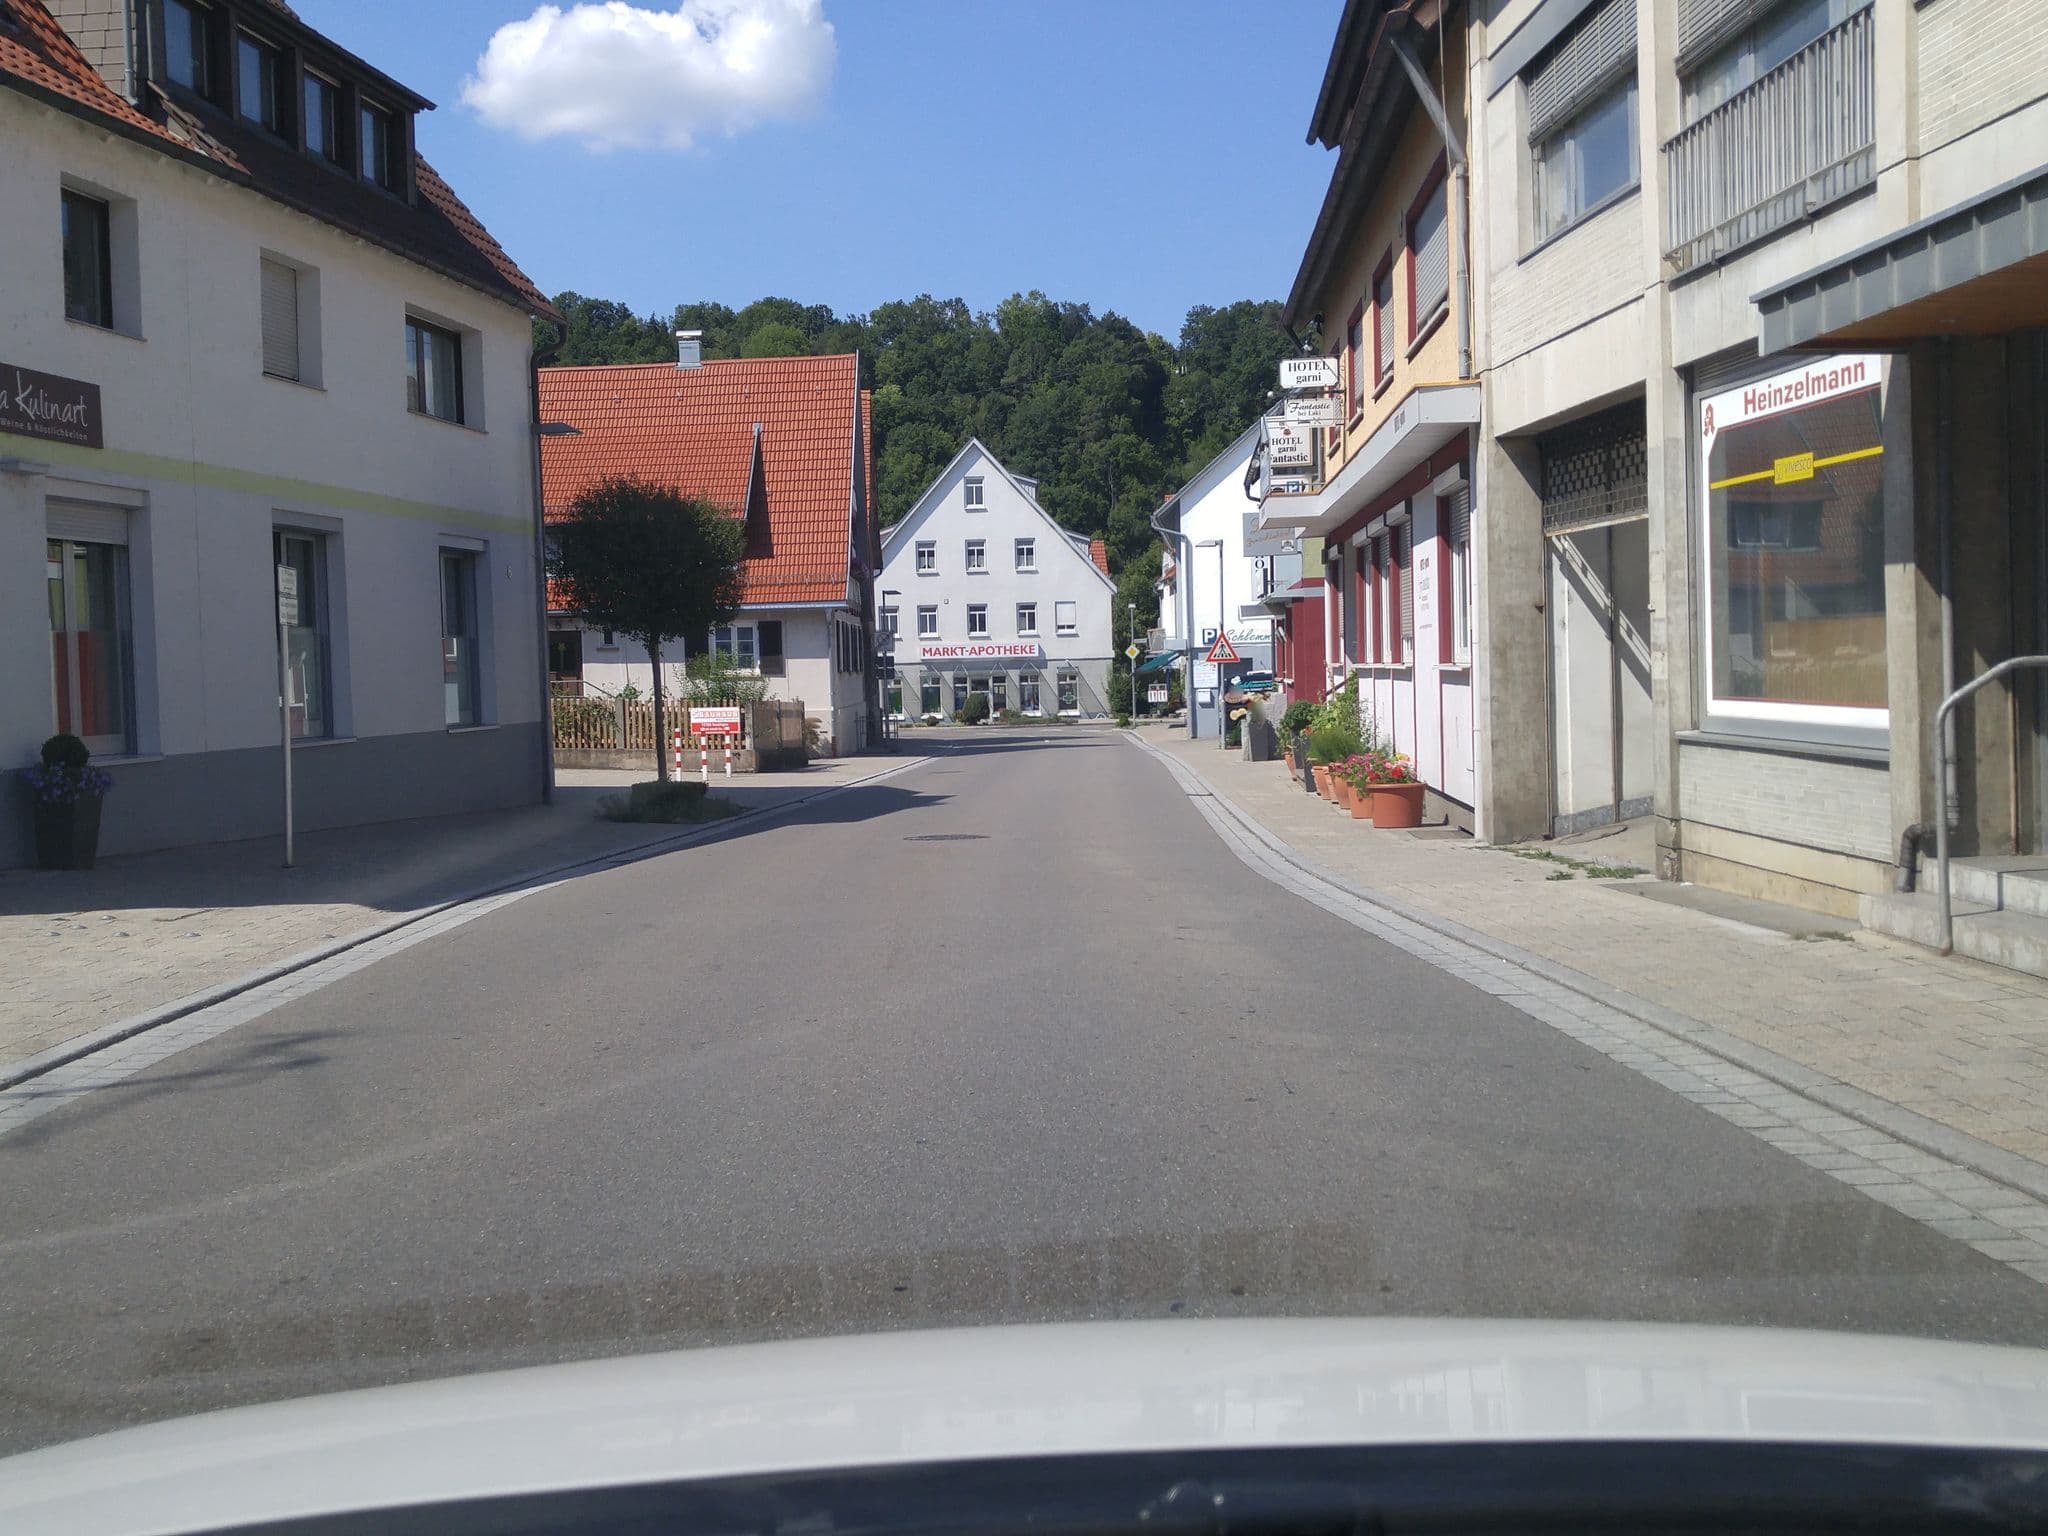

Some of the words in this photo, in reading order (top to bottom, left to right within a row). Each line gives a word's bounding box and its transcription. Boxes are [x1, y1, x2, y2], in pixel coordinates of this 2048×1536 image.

[1288, 361, 1330, 372] HOTEL
[1296, 373, 1322, 384] garni
[1743, 360, 1866, 415] Heinzelmann
[15, 370, 88, 427] Kulinart
[1288, 402, 1331, 414] Fantastic
[1272, 437, 1303, 446] HOTEL
[1278, 445, 1297, 454] garni
[922, 644, 1036, 657] MARKT-APOTHEKE
